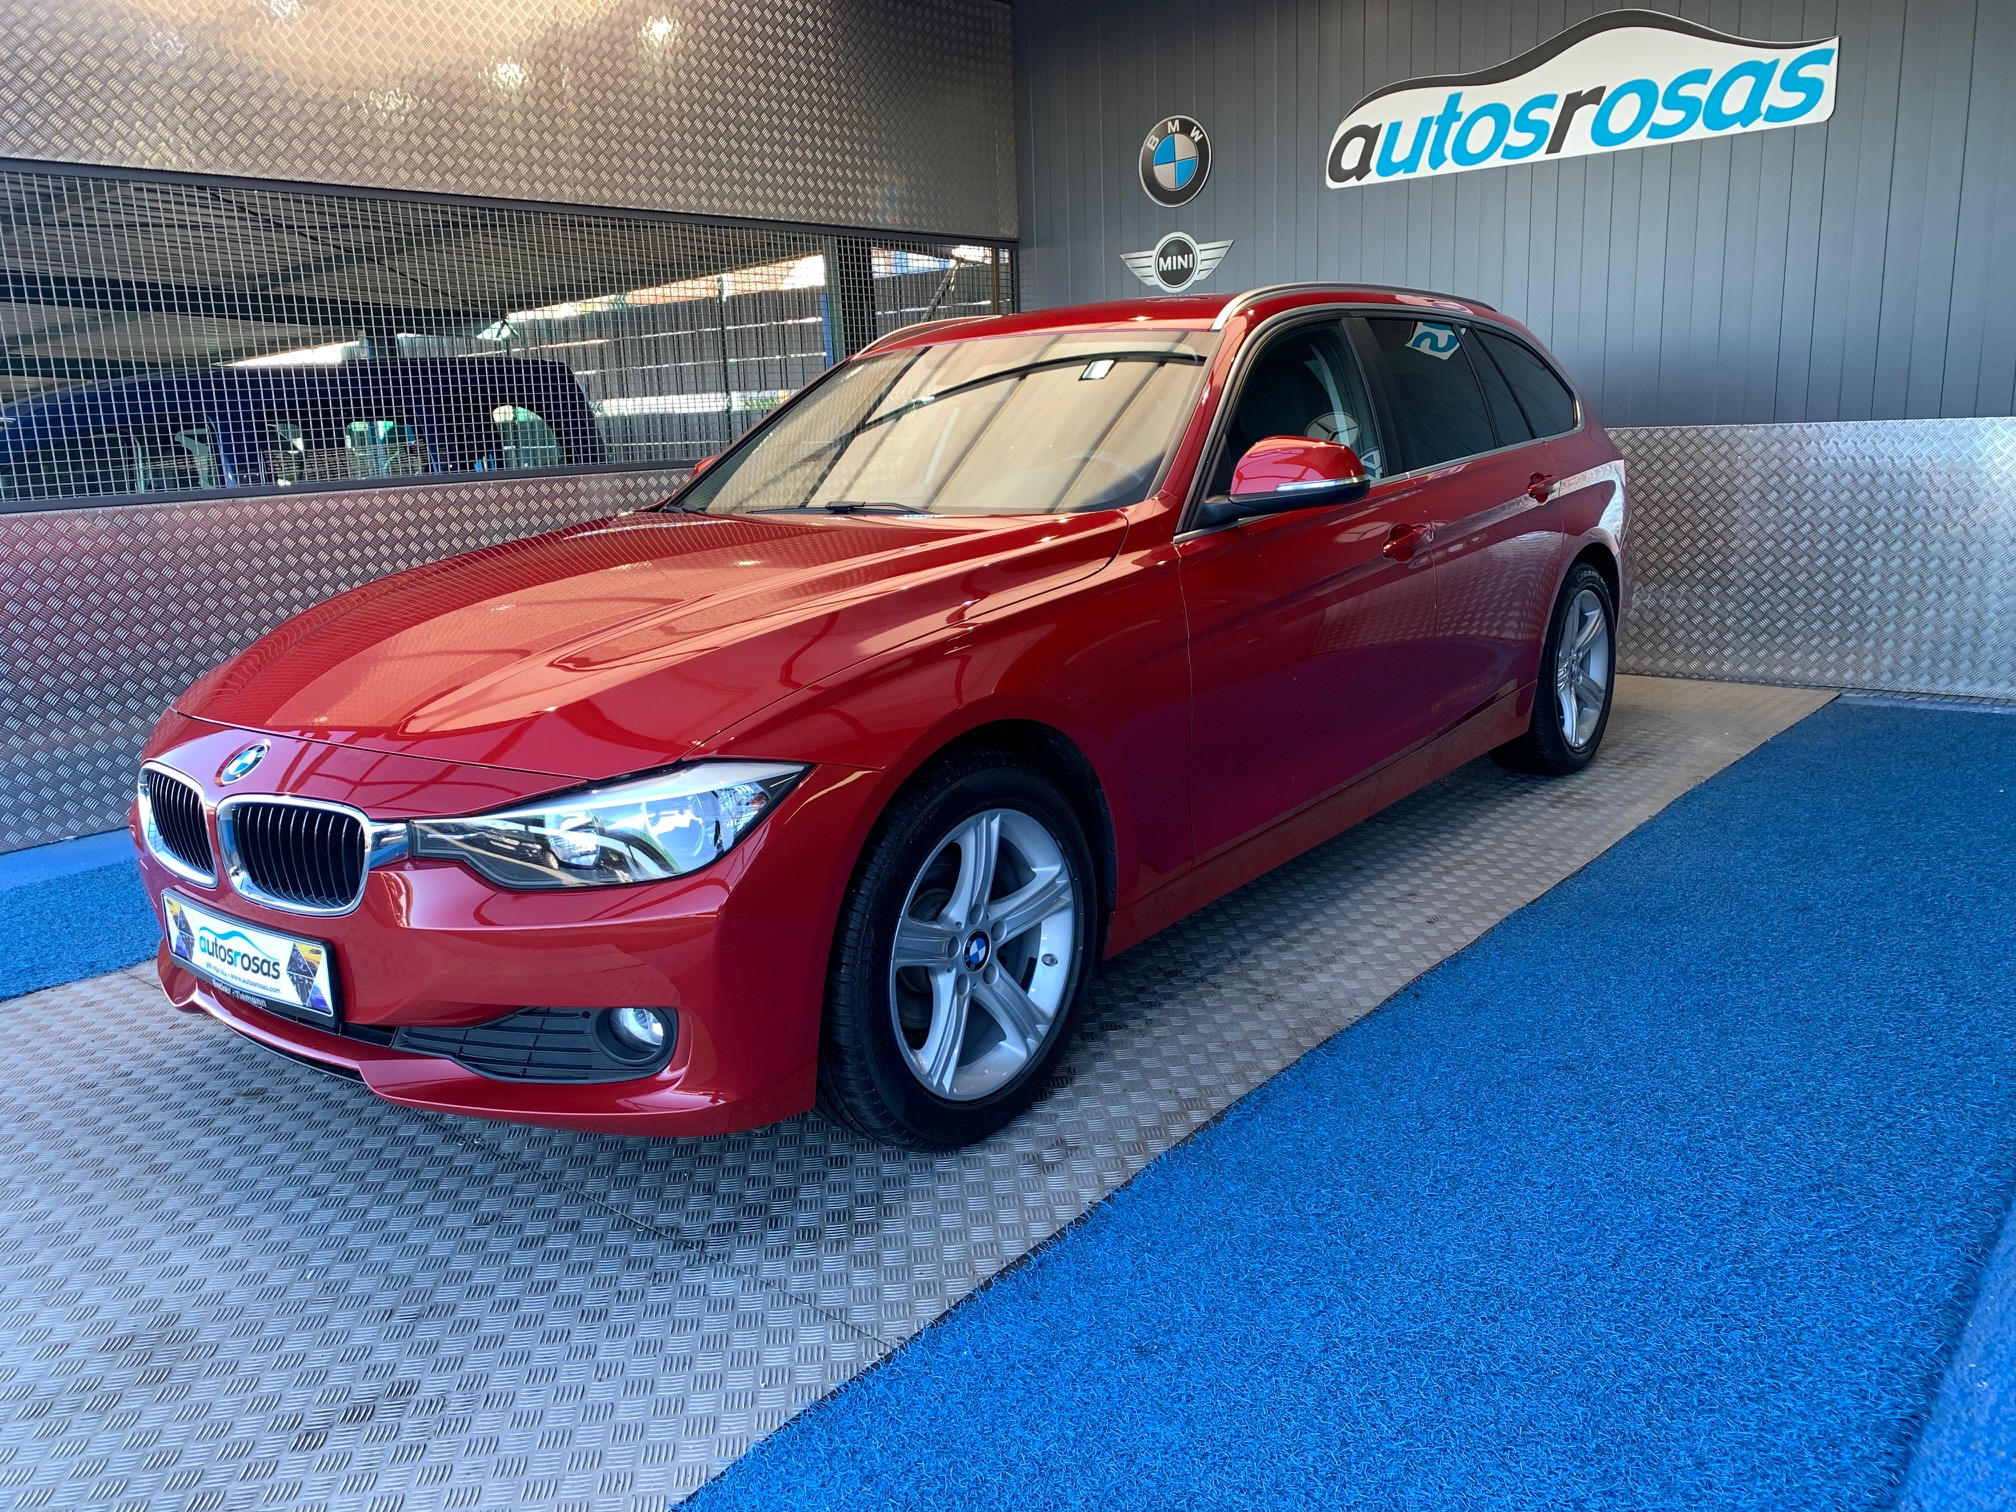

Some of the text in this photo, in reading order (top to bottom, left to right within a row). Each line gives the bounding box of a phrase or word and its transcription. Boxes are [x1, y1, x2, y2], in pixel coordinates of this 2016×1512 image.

[1328, 48, 1836, 183] autosrosas
[1147, 119, 1203, 151] BMW
[1158, 253, 1194, 272] MINI
[199, 936, 281, 979] autosrosas
